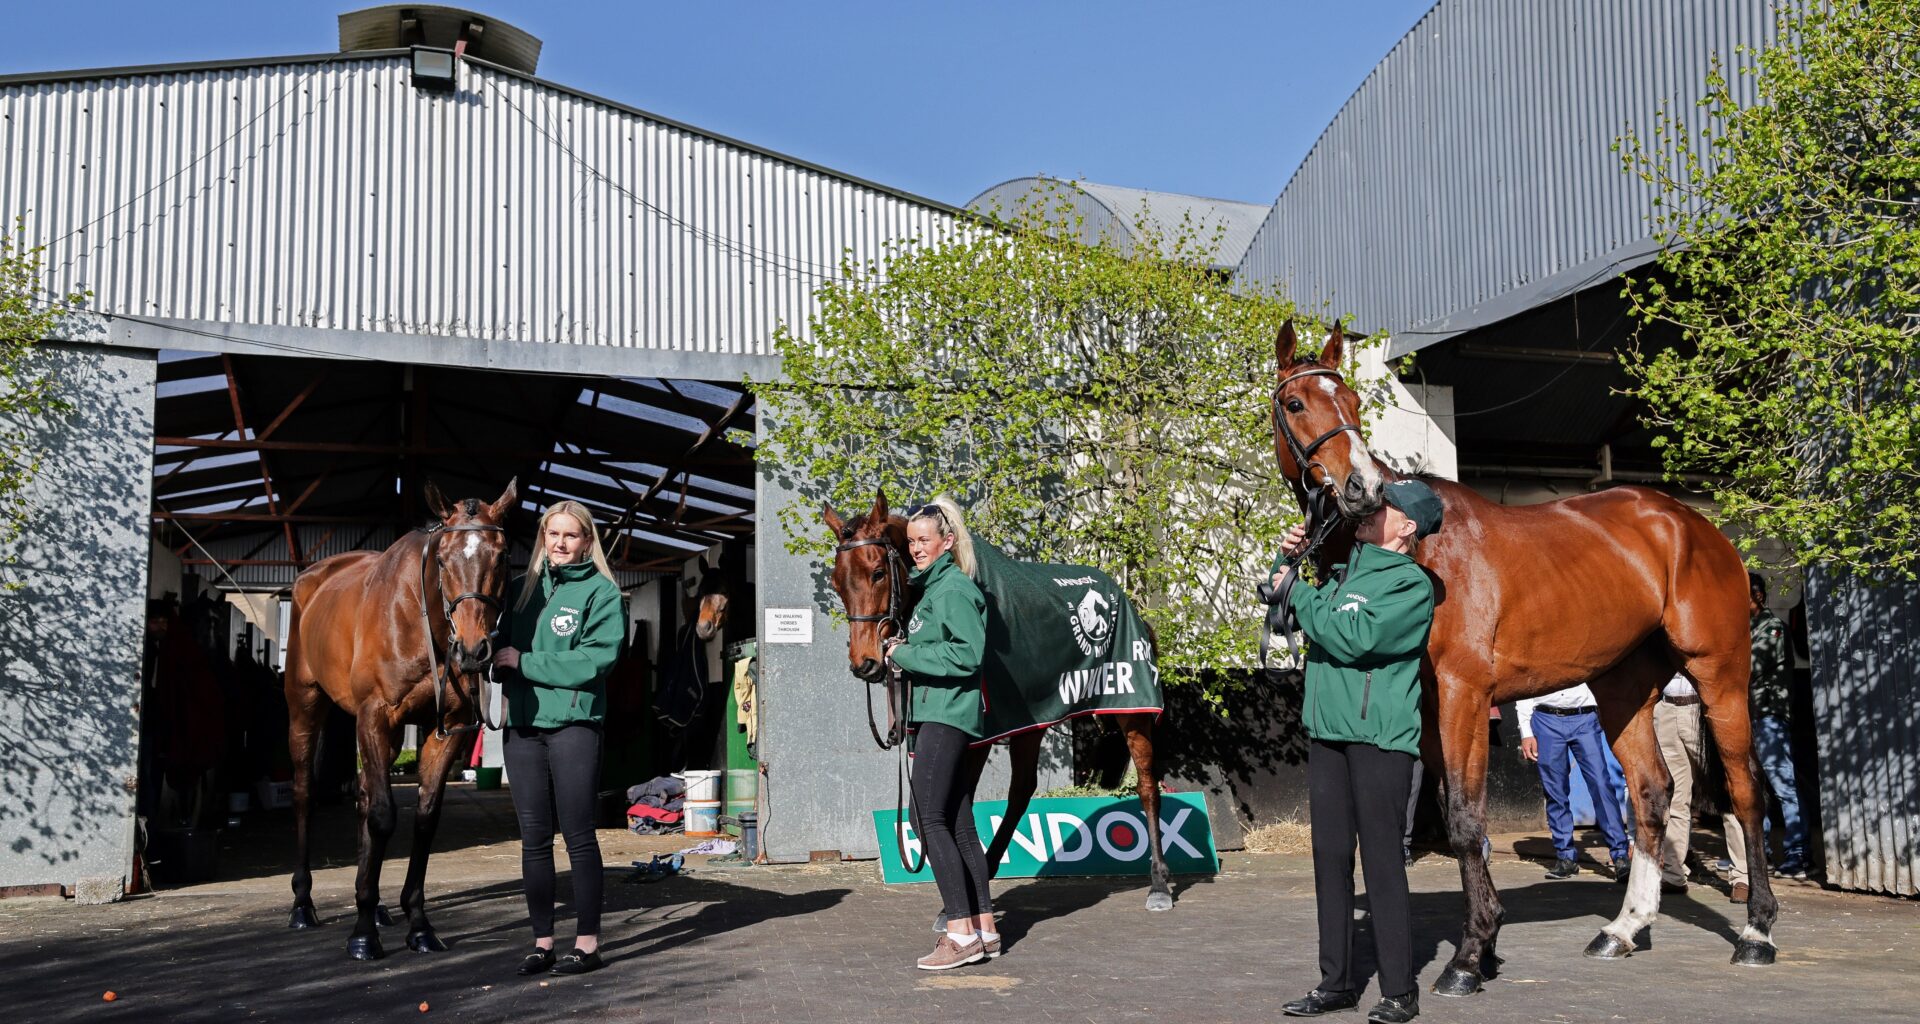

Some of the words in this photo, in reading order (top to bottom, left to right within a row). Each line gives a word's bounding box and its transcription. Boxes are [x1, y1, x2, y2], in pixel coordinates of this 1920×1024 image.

[1052, 575, 1098, 587] RANDOX
[1070, 615, 1092, 656] GRAND
[893, 808, 1204, 868] RNDOX
